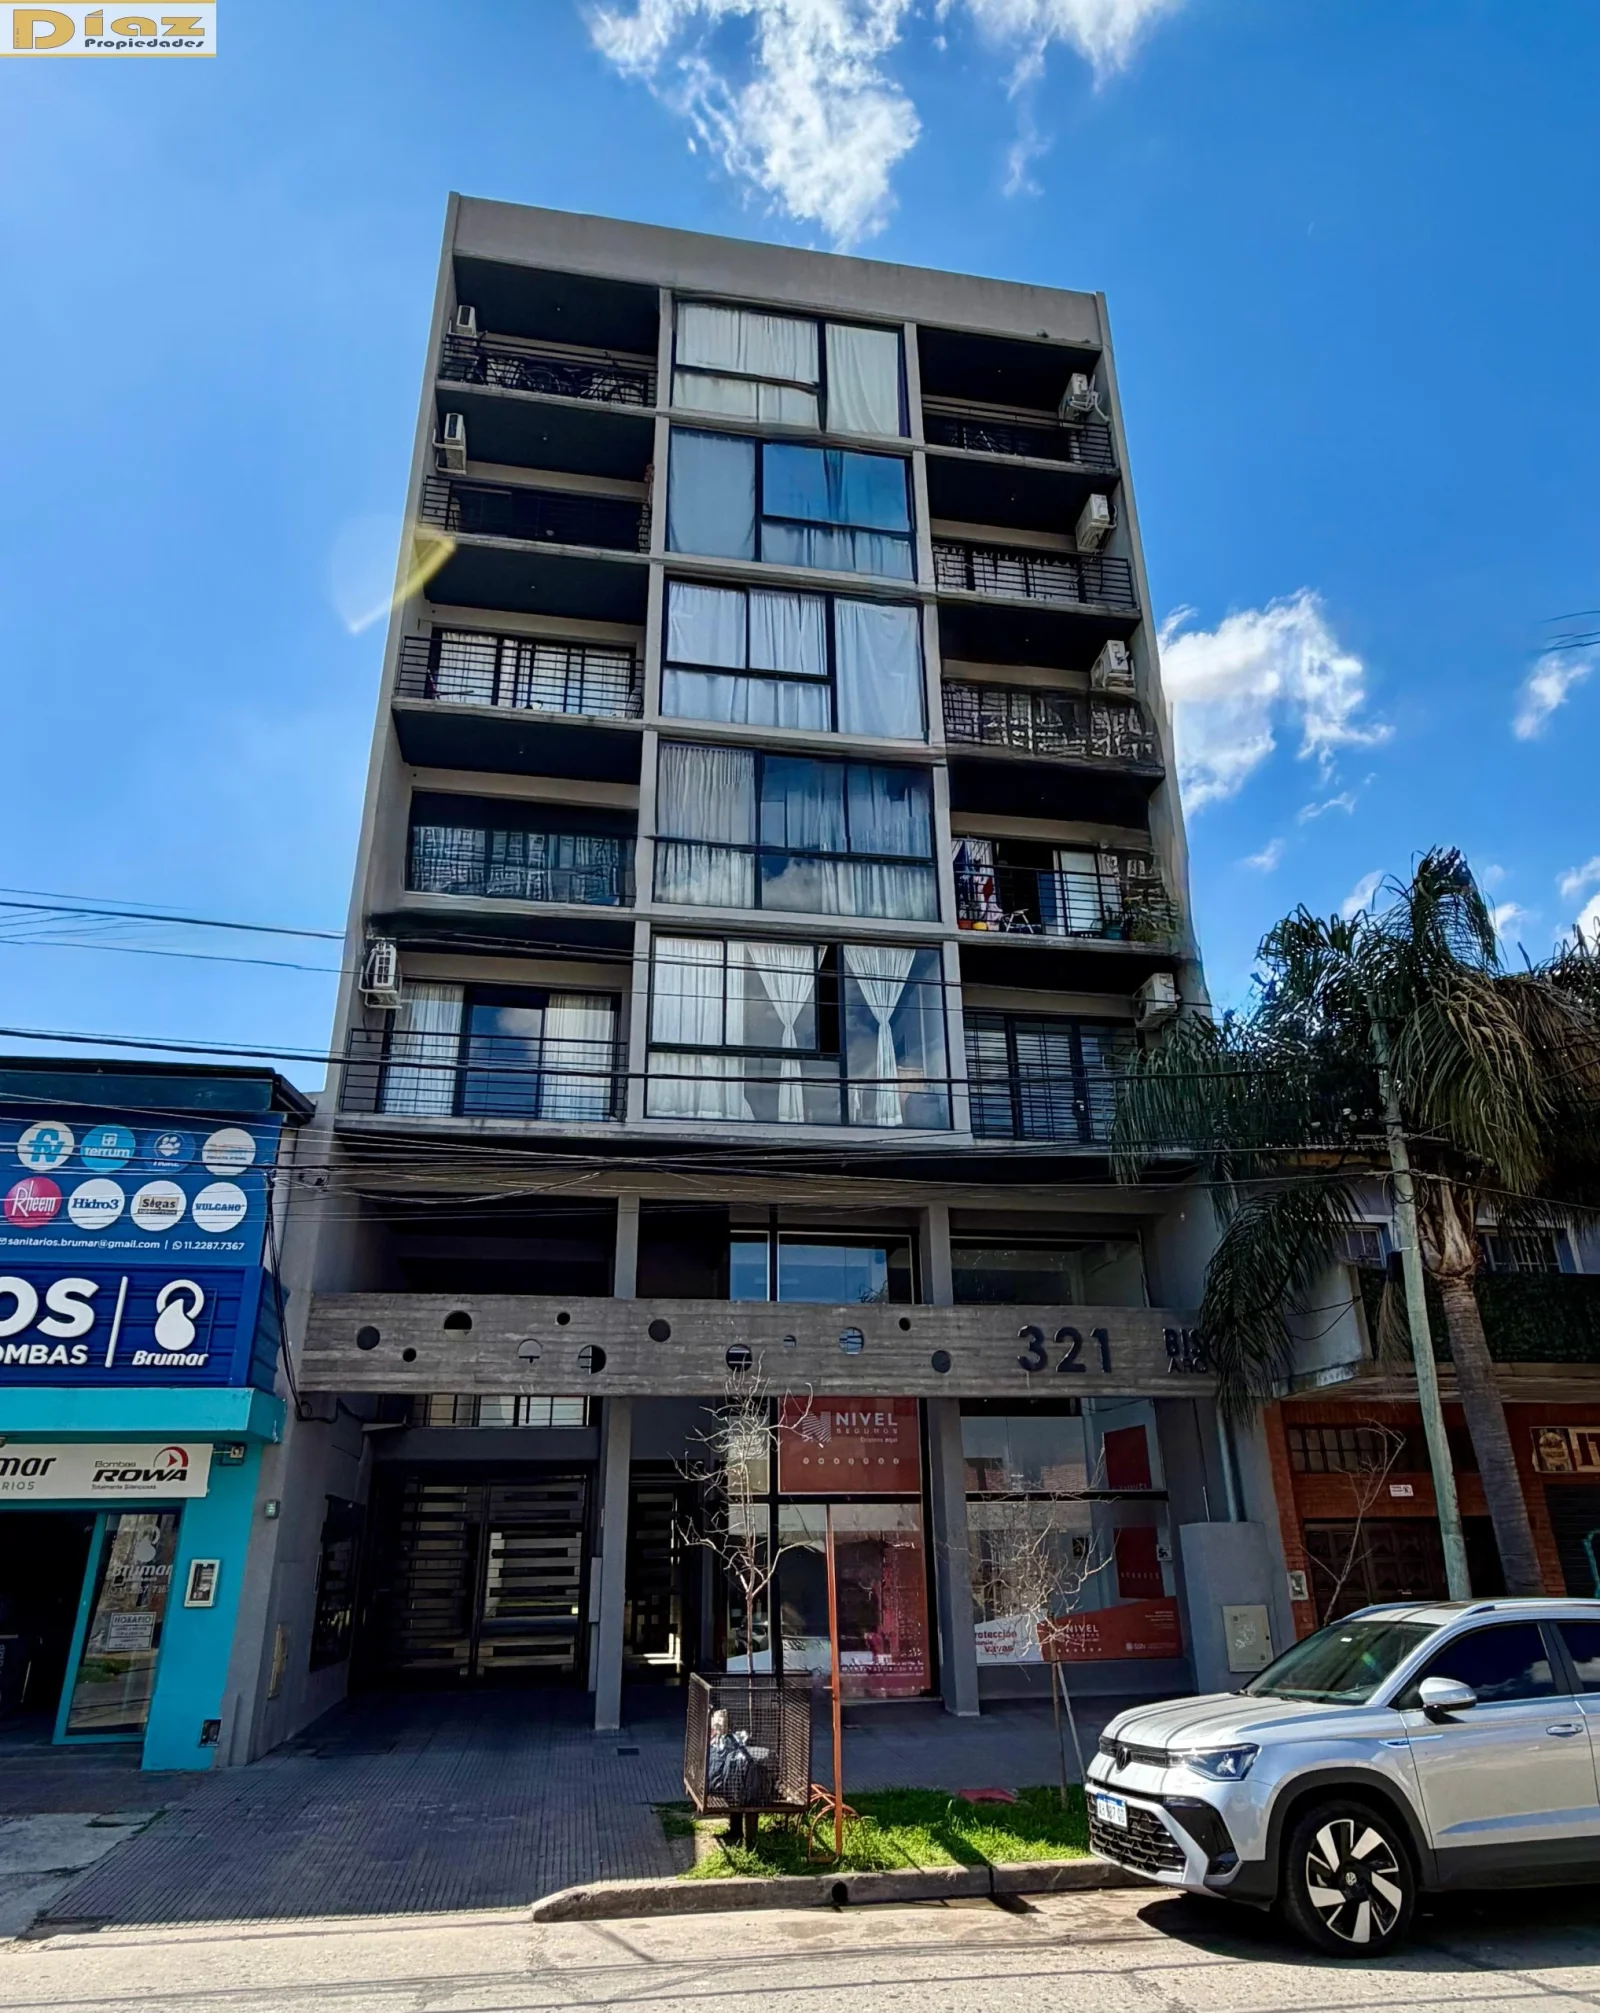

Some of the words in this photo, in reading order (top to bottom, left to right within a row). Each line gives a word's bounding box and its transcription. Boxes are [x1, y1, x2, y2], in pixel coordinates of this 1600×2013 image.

[12, 1180, 56, 1217] Rheem
[72, 1197, 119, 1210] Hidro3
[142, 1198, 176, 1210] Sigas
[196, 1203, 242, 1211] VULCANO
[8, 1237, 160, 1250] sanitarios.brumar@gmail.com
[184, 1241, 244, 1251] 11.2287.7367
[0, 1344, 88, 1365] MBAS
[1017, 1325, 1112, 1374] 321
[132, 1350, 209, 1366] Brumar
[836, 1412, 898, 1426] NIVEL
[95, 1460, 136, 1468] Bombas
[92, 1469, 188, 1482] ROWA
[2, 1481, 36, 1490] RIOS
[975, 1630, 1017, 1639] rotección
[1066, 1624, 1099, 1633] NIVEL
